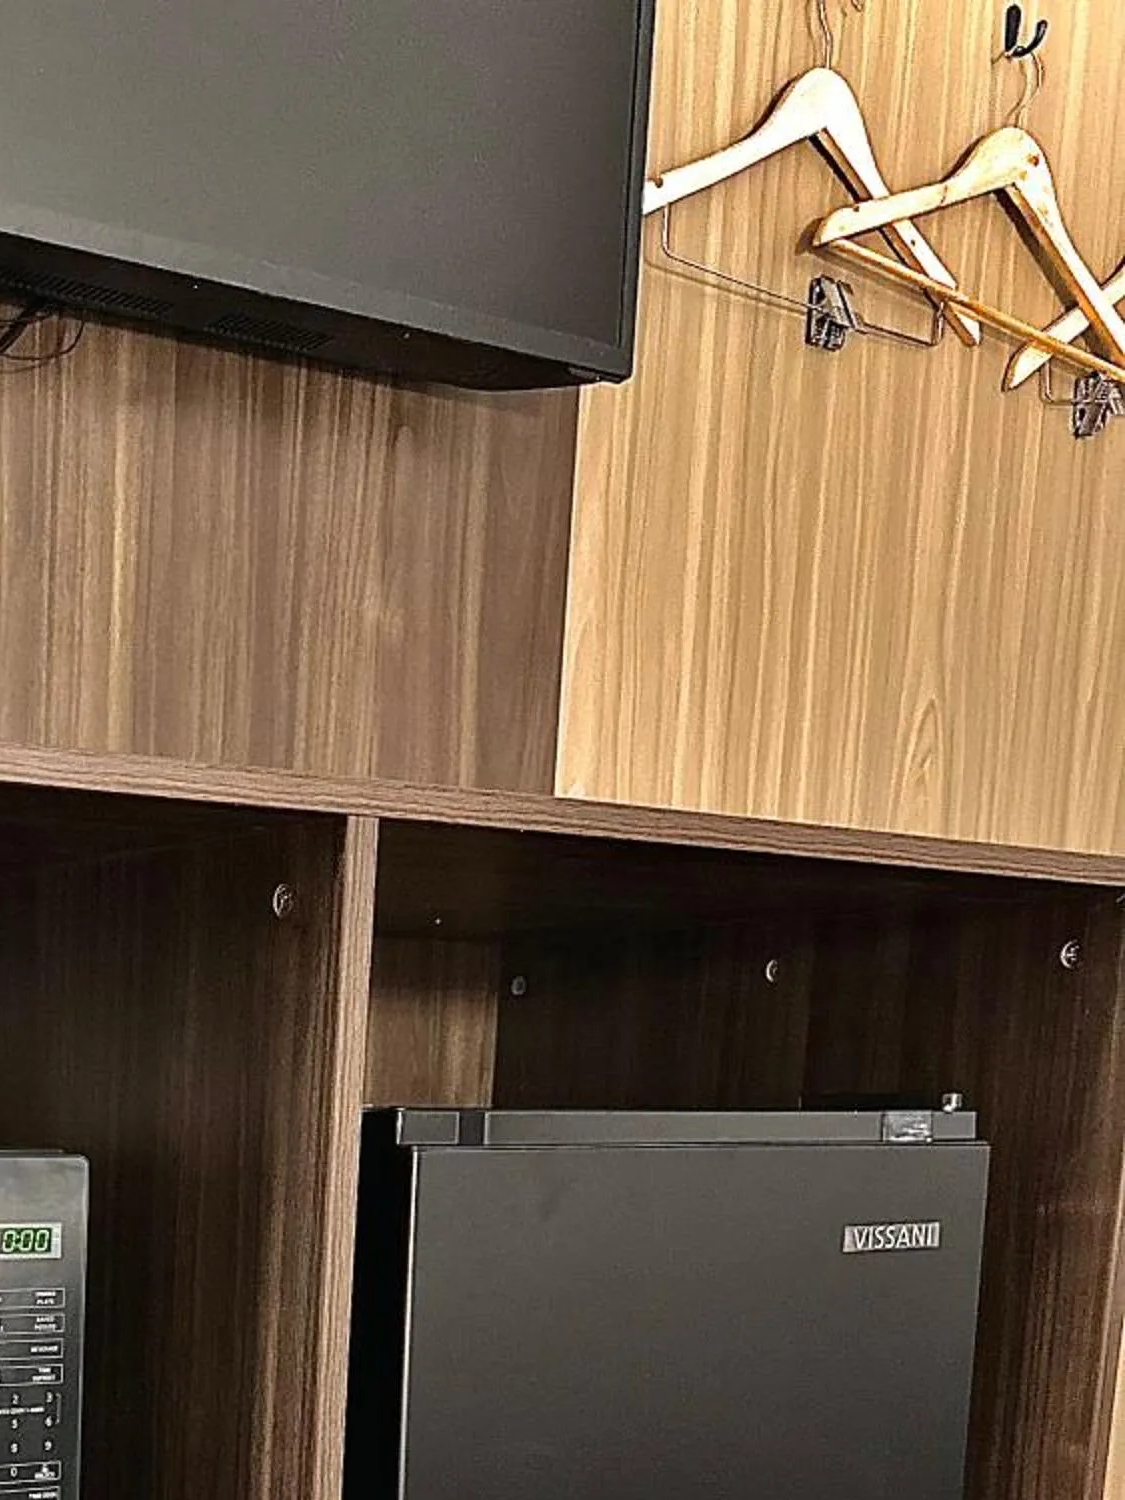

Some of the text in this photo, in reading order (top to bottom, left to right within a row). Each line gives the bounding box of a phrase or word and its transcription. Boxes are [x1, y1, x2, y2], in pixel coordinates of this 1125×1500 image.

[2, 1229, 50, 1253] 0:00
[854, 1224, 933, 1250] VISSANI
[10, 1467, 18, 1478] 0
